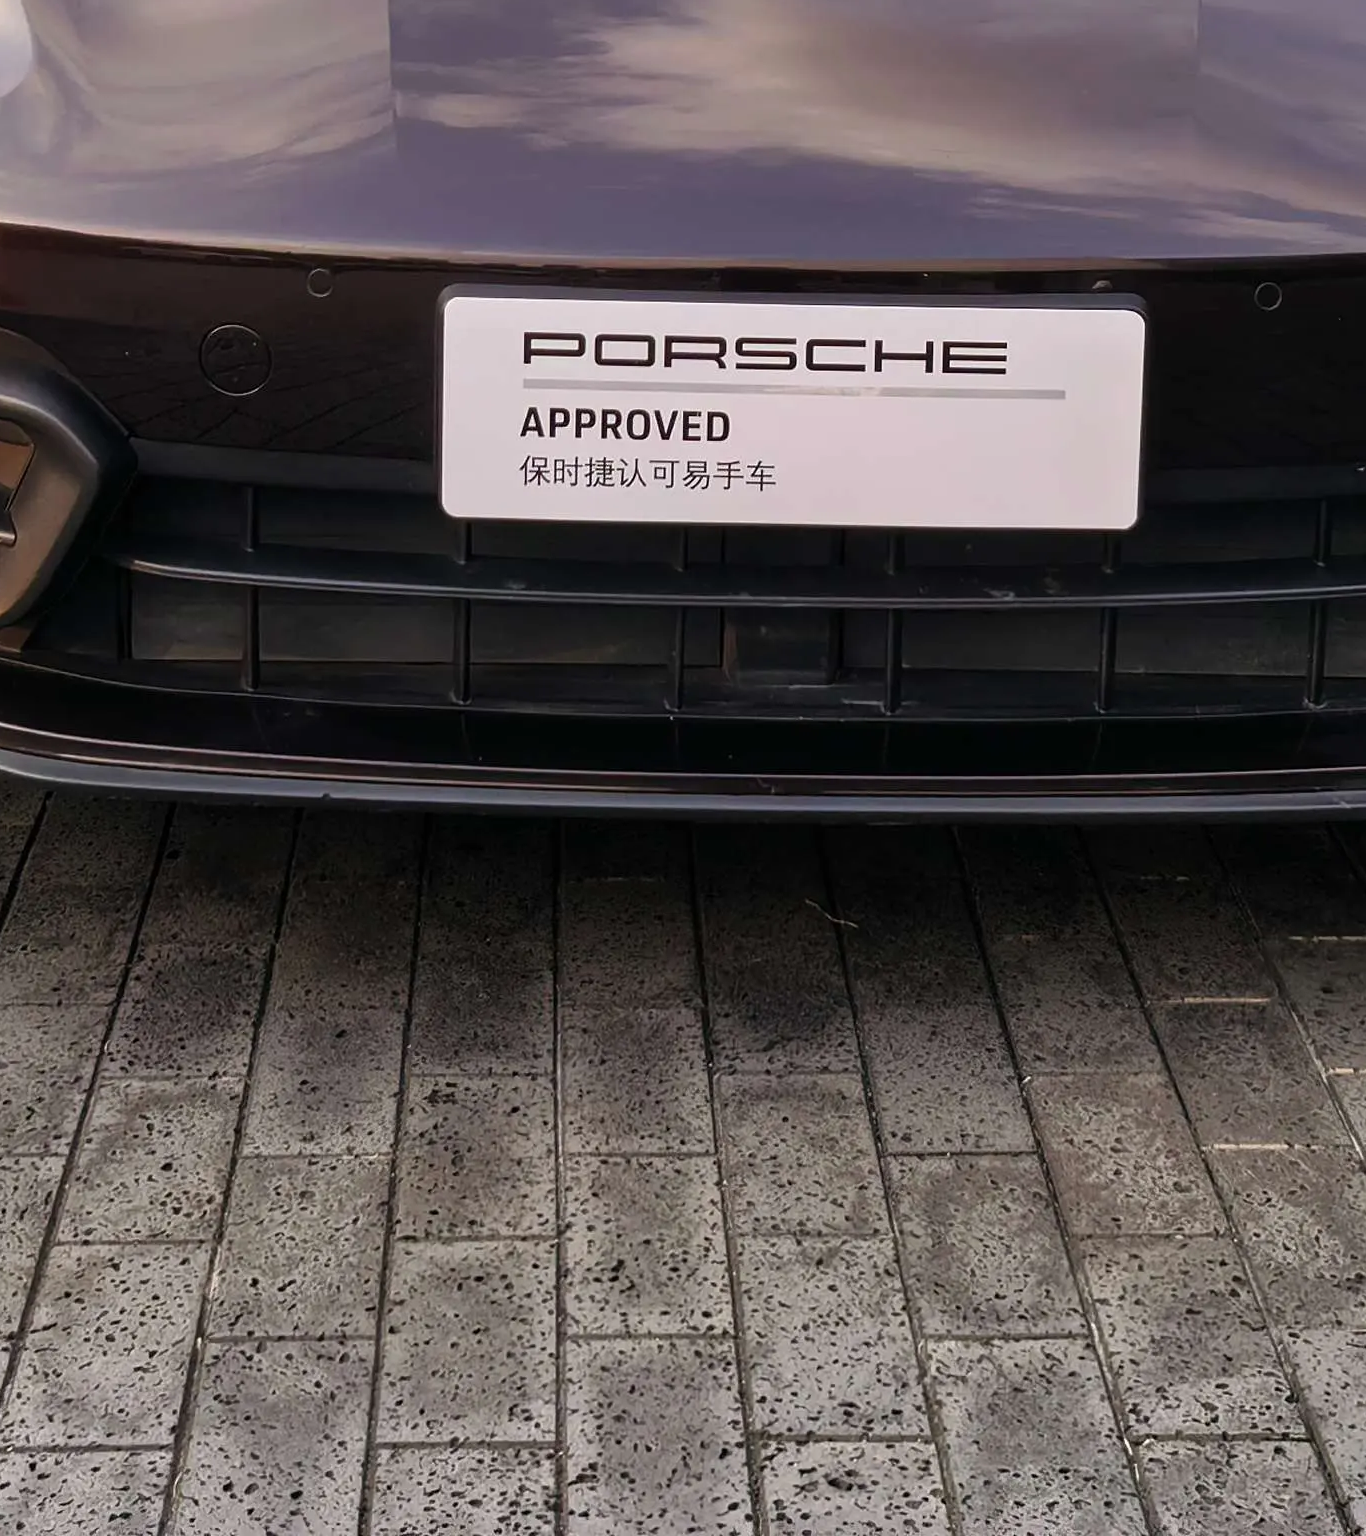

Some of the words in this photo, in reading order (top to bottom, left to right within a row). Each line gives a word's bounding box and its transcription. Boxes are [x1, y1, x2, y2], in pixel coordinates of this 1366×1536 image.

[523, 331, 1008, 375] PORSCHE
[520, 406, 731, 443] APPROVED
[519, 454, 777, 492] 保时捷认可易手车
